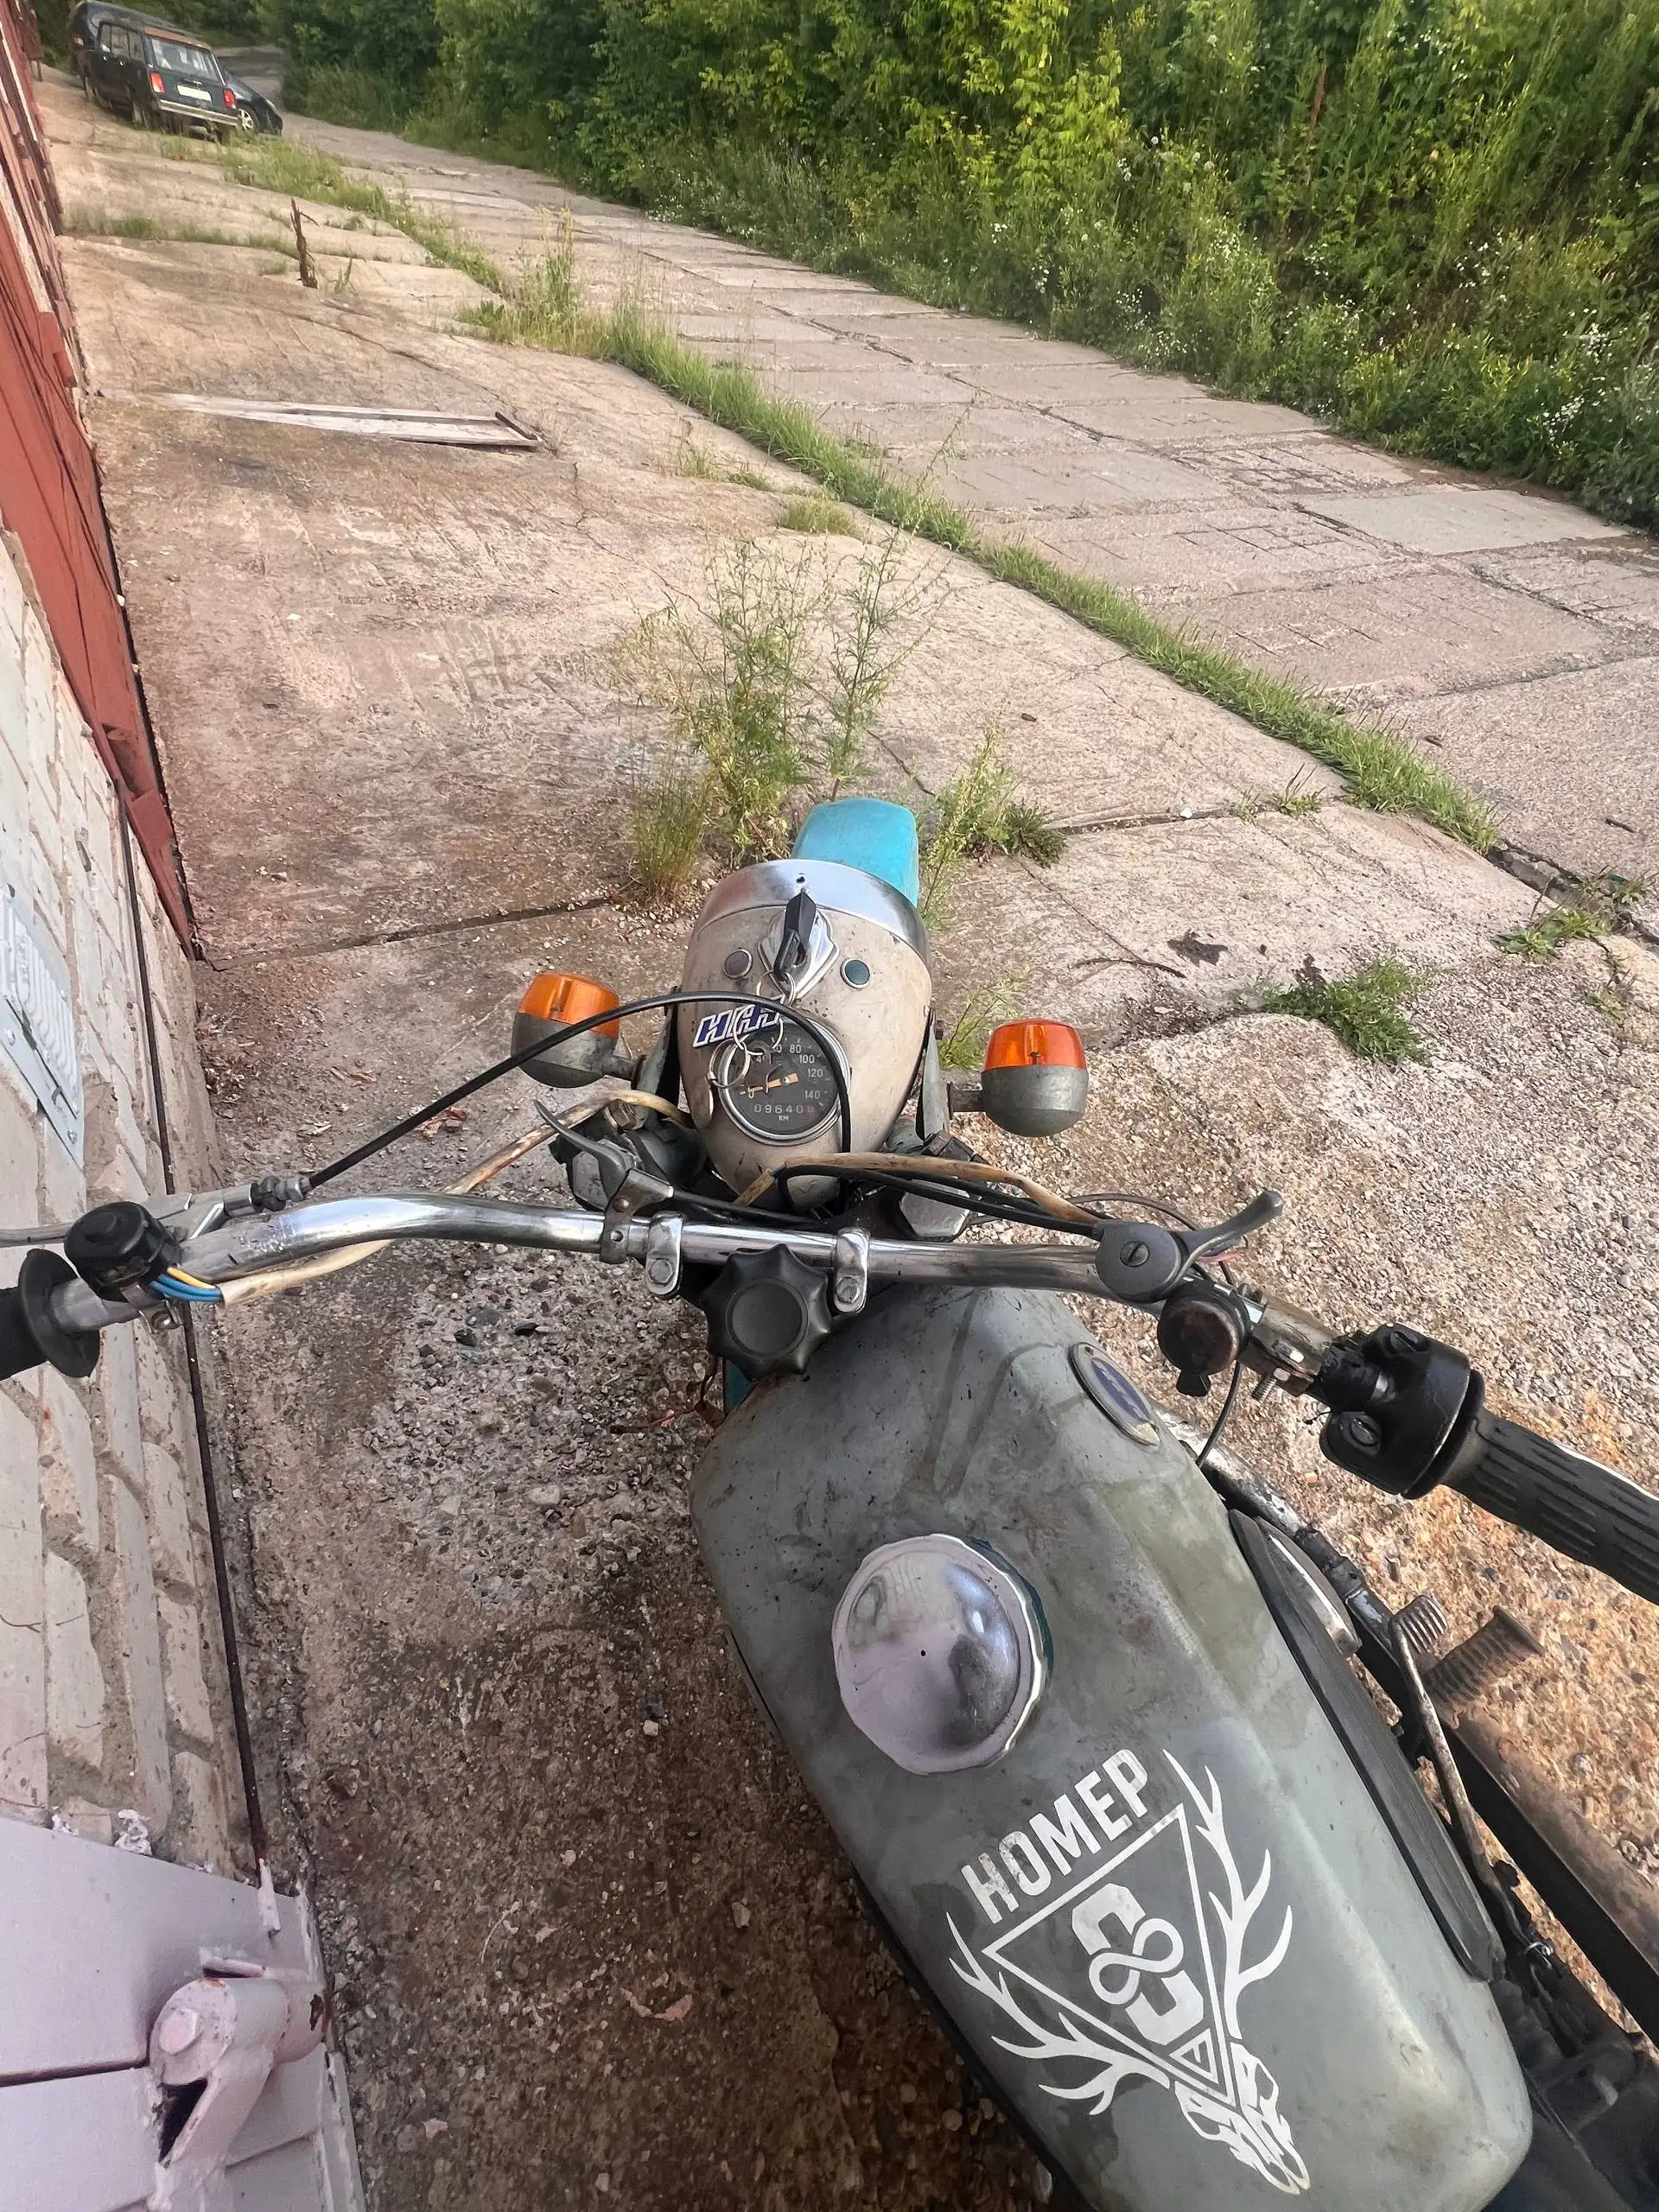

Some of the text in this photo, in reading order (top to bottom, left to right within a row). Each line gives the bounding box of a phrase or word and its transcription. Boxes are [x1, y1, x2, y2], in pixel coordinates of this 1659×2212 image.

[789, 1044, 802, 1054] 80
[799, 1053, 815, 1064] 100
[807, 1068, 823, 1078] 120
[804, 1090, 821, 1100] 140
[960, 1748, 1148, 1924] НОМЕР
